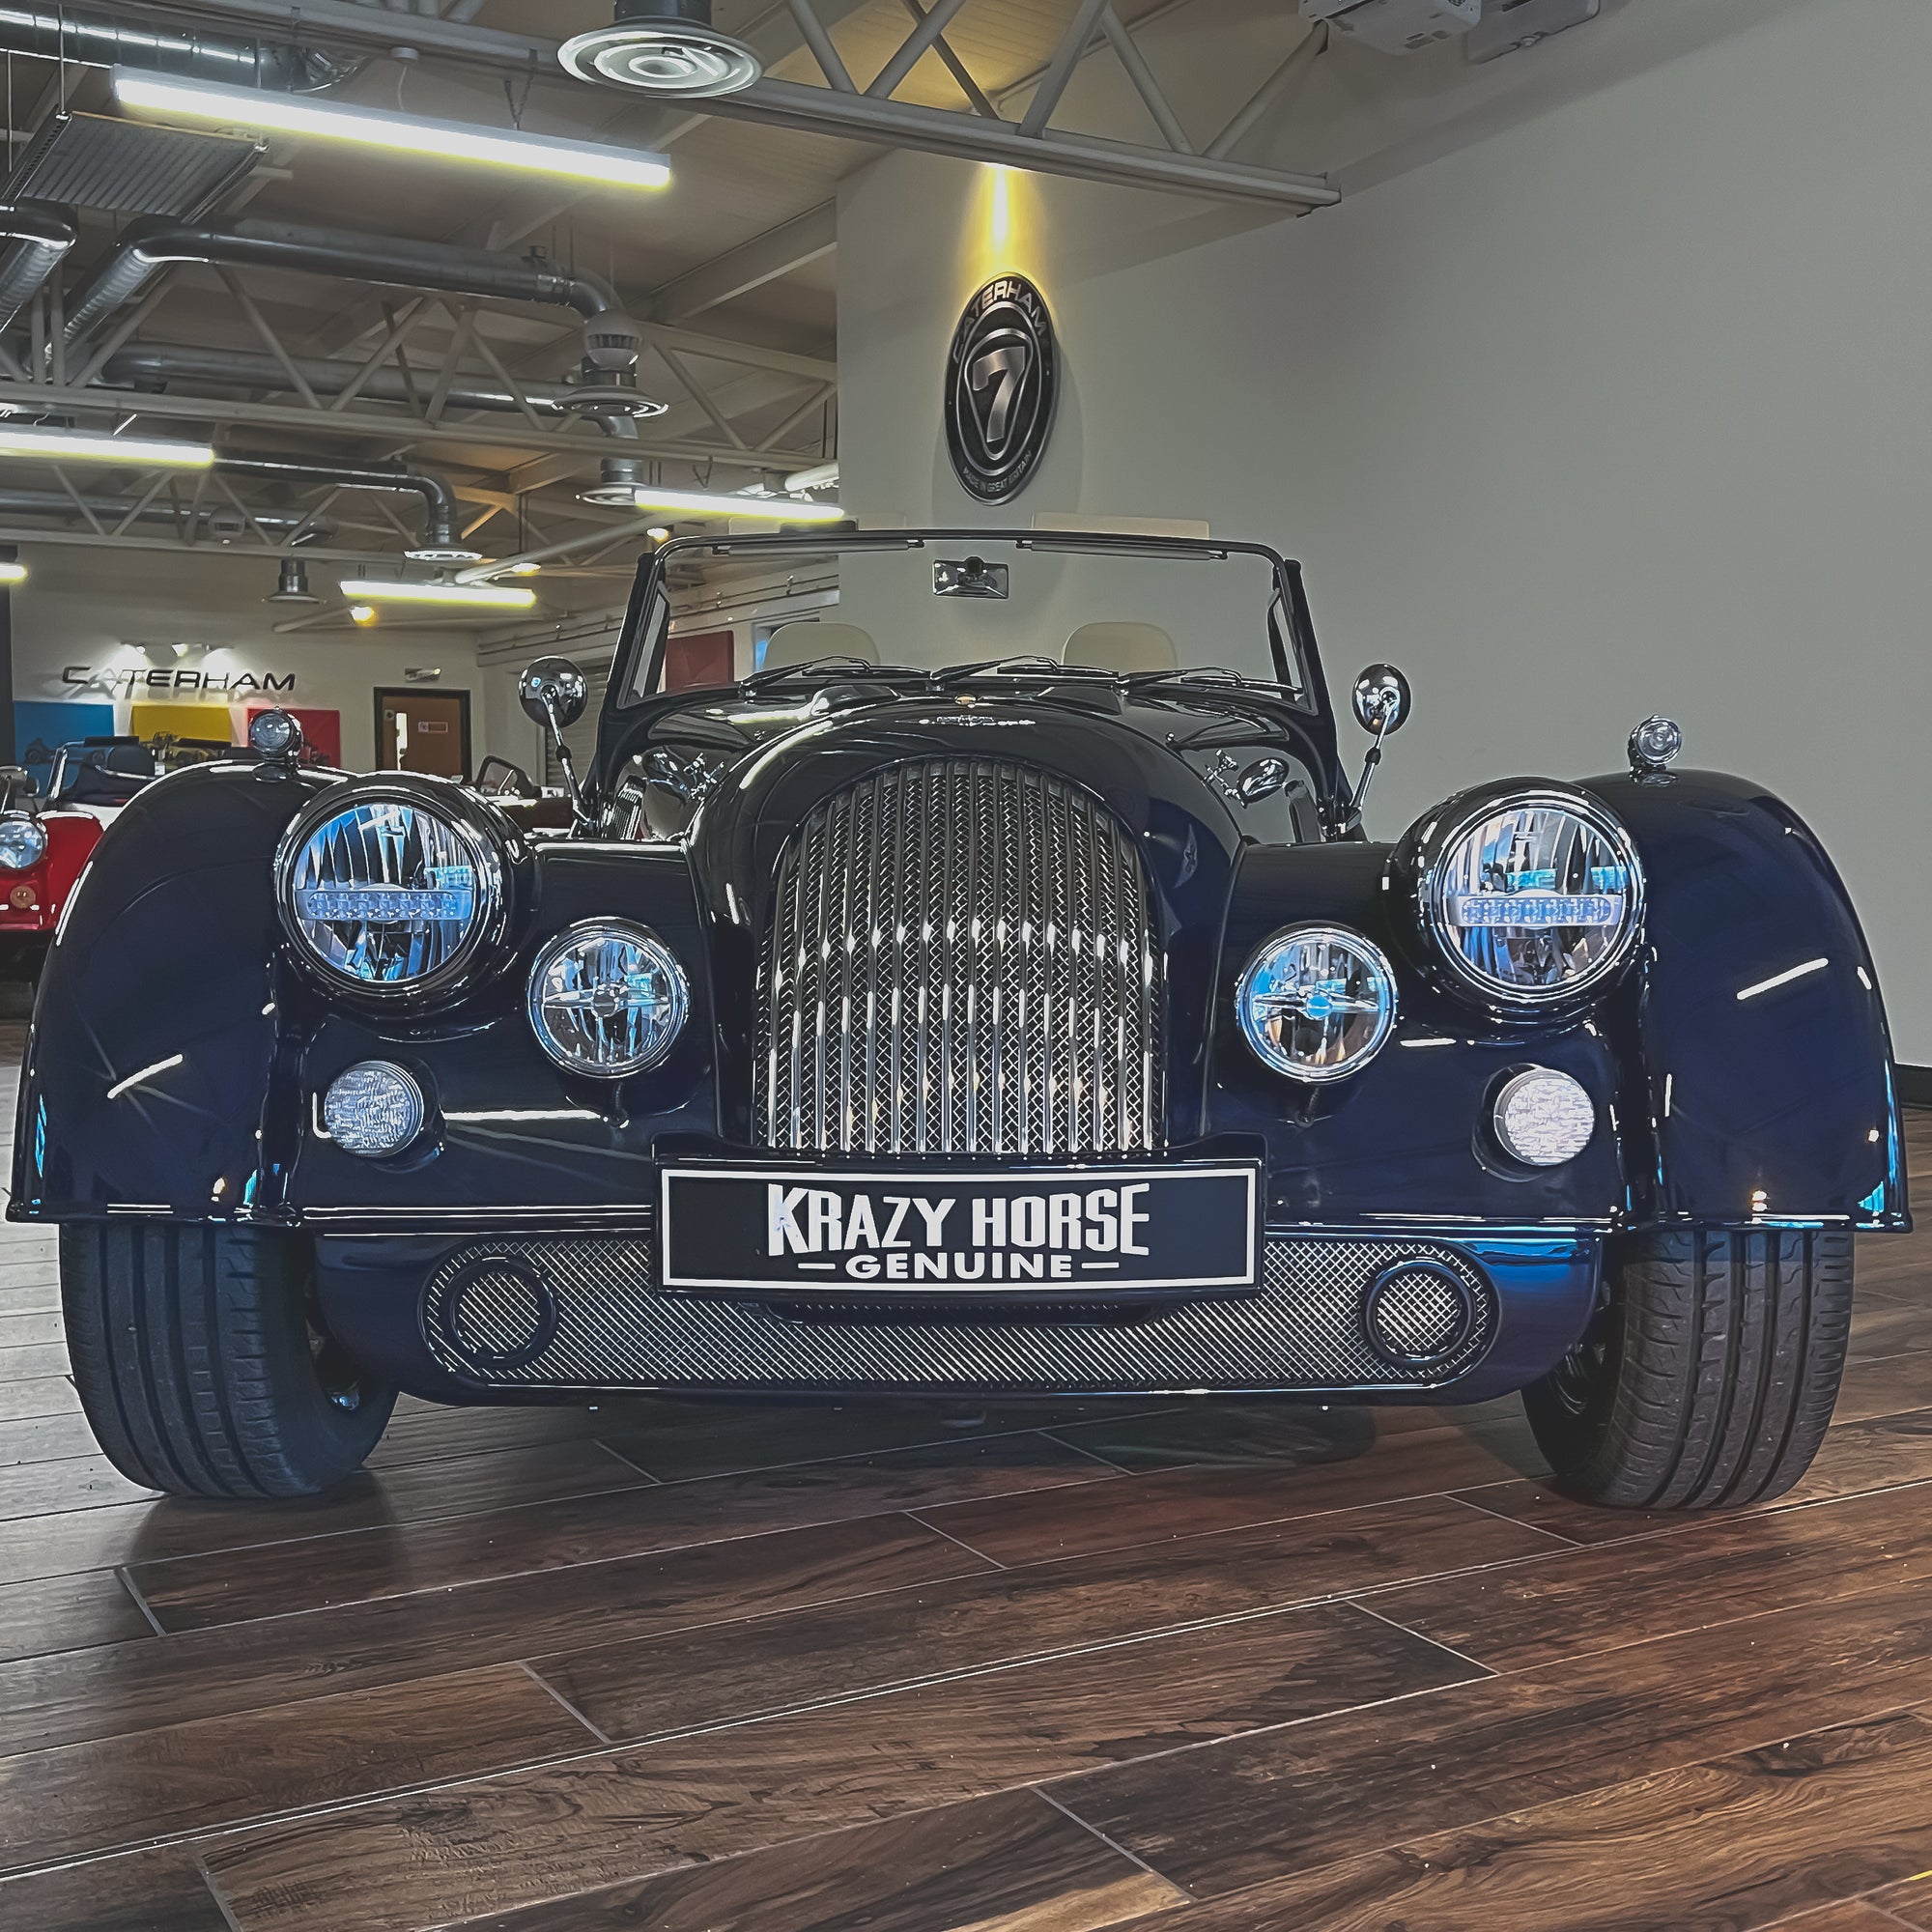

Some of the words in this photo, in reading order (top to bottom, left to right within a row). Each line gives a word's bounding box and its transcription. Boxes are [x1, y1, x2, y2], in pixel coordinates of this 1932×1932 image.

[952, 280, 1047, 363] CATERHAM
[973, 346, 1025, 442] 7
[62, 666, 296, 692] CATERHAM
[767, 1182, 957, 1257] KRAZY
[972, 1182, 1151, 1256] HORSE
[845, 1253, 1073, 1280] GENUINE
